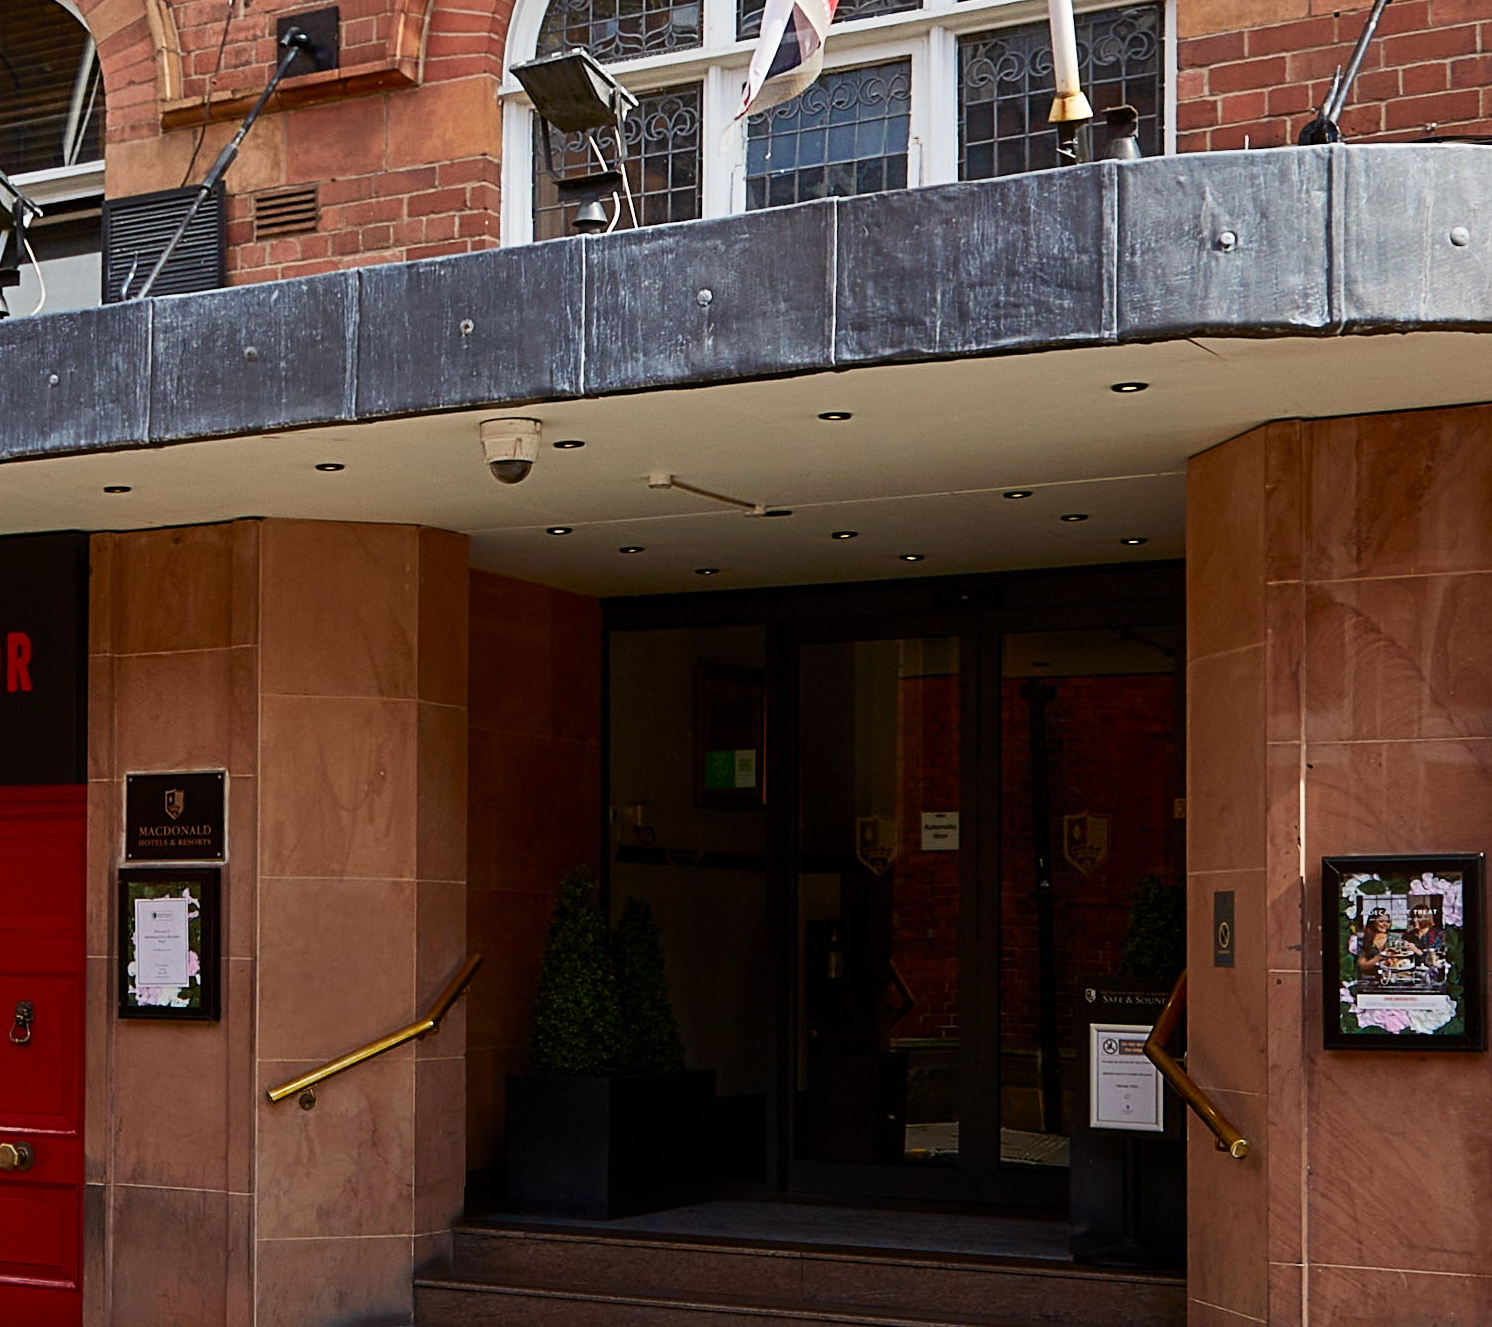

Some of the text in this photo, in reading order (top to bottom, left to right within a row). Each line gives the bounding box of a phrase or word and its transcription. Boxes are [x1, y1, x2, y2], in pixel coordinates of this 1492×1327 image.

[139, 825, 212, 836] MACDONALD
[138, 838, 167, 846] HOTELS
[178, 838, 211, 846] RESORTS
